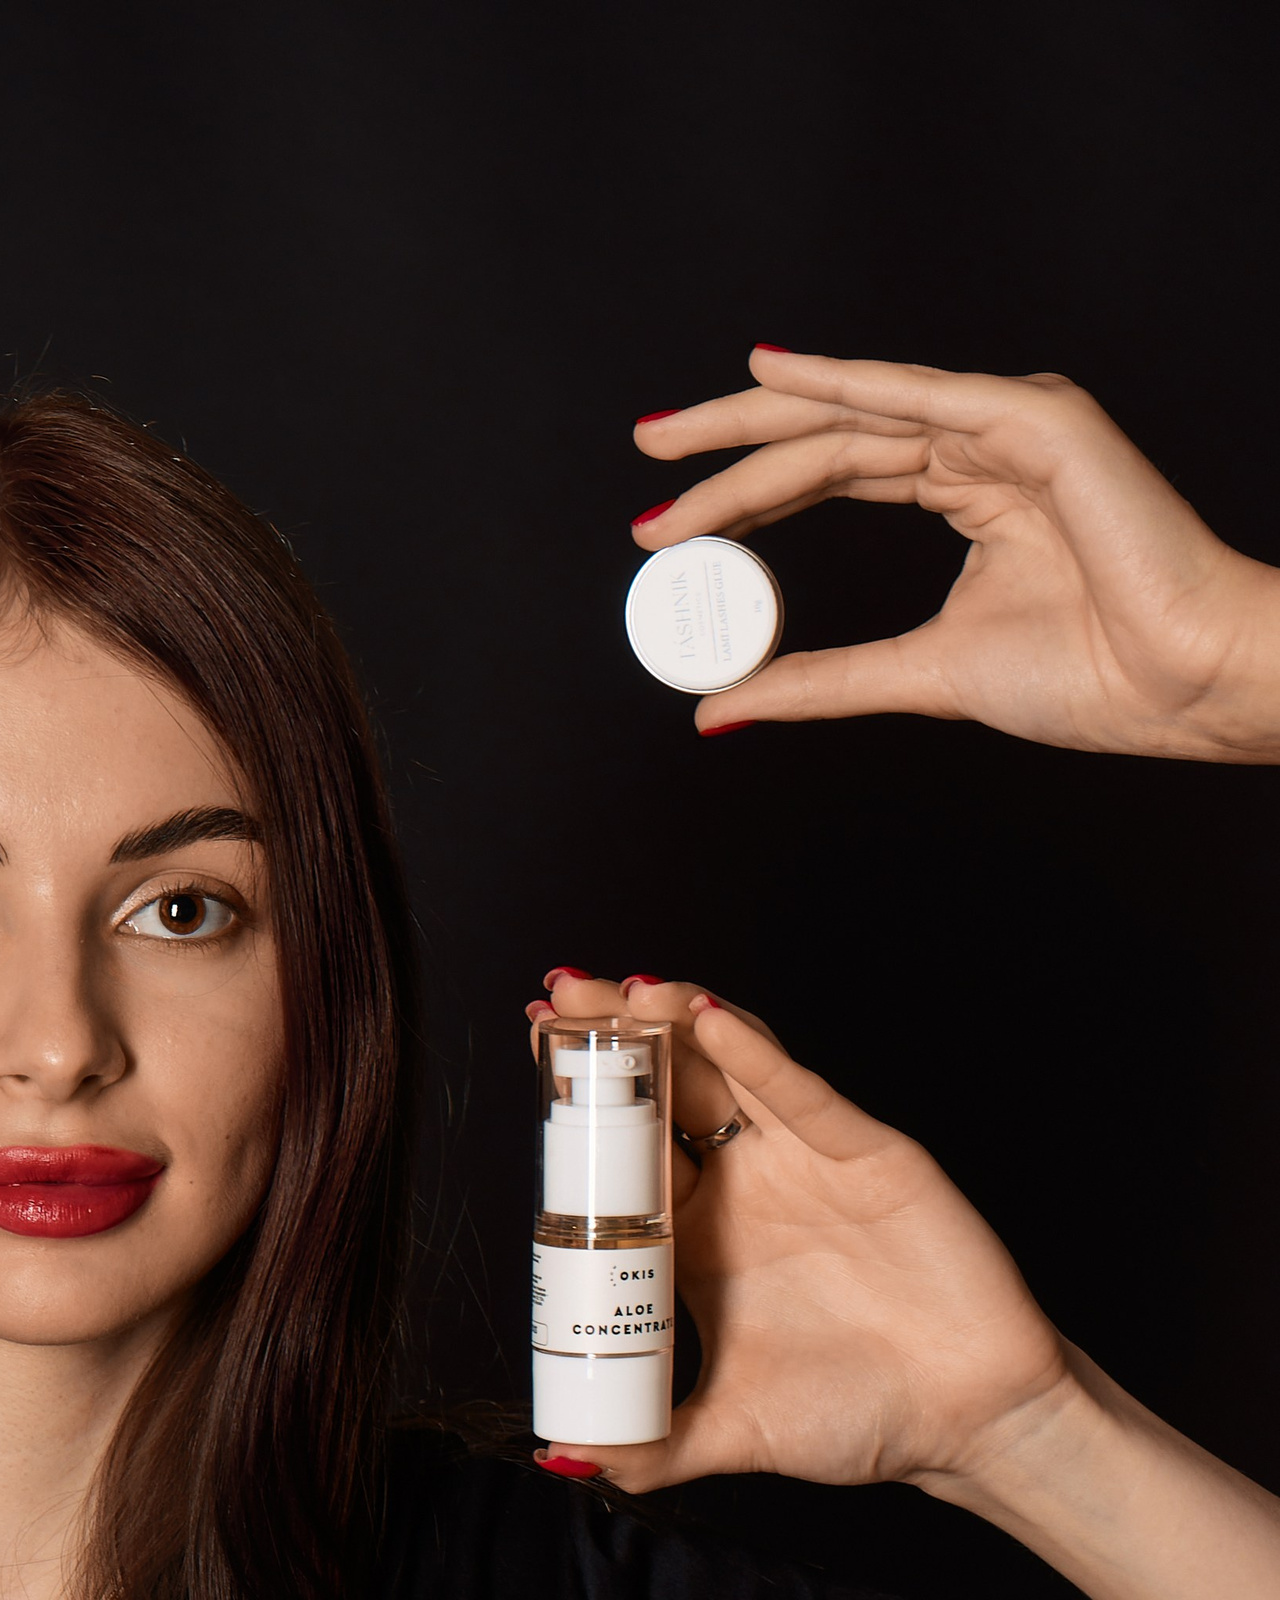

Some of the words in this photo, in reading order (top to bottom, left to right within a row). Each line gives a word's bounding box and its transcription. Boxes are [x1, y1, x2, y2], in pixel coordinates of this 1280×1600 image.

[712, 560, 725, 590] GLUE
[716, 591, 730, 632] LASHES
[620, 1268, 655, 1281] OKIS
[614, 1303, 654, 1317] ALOE
